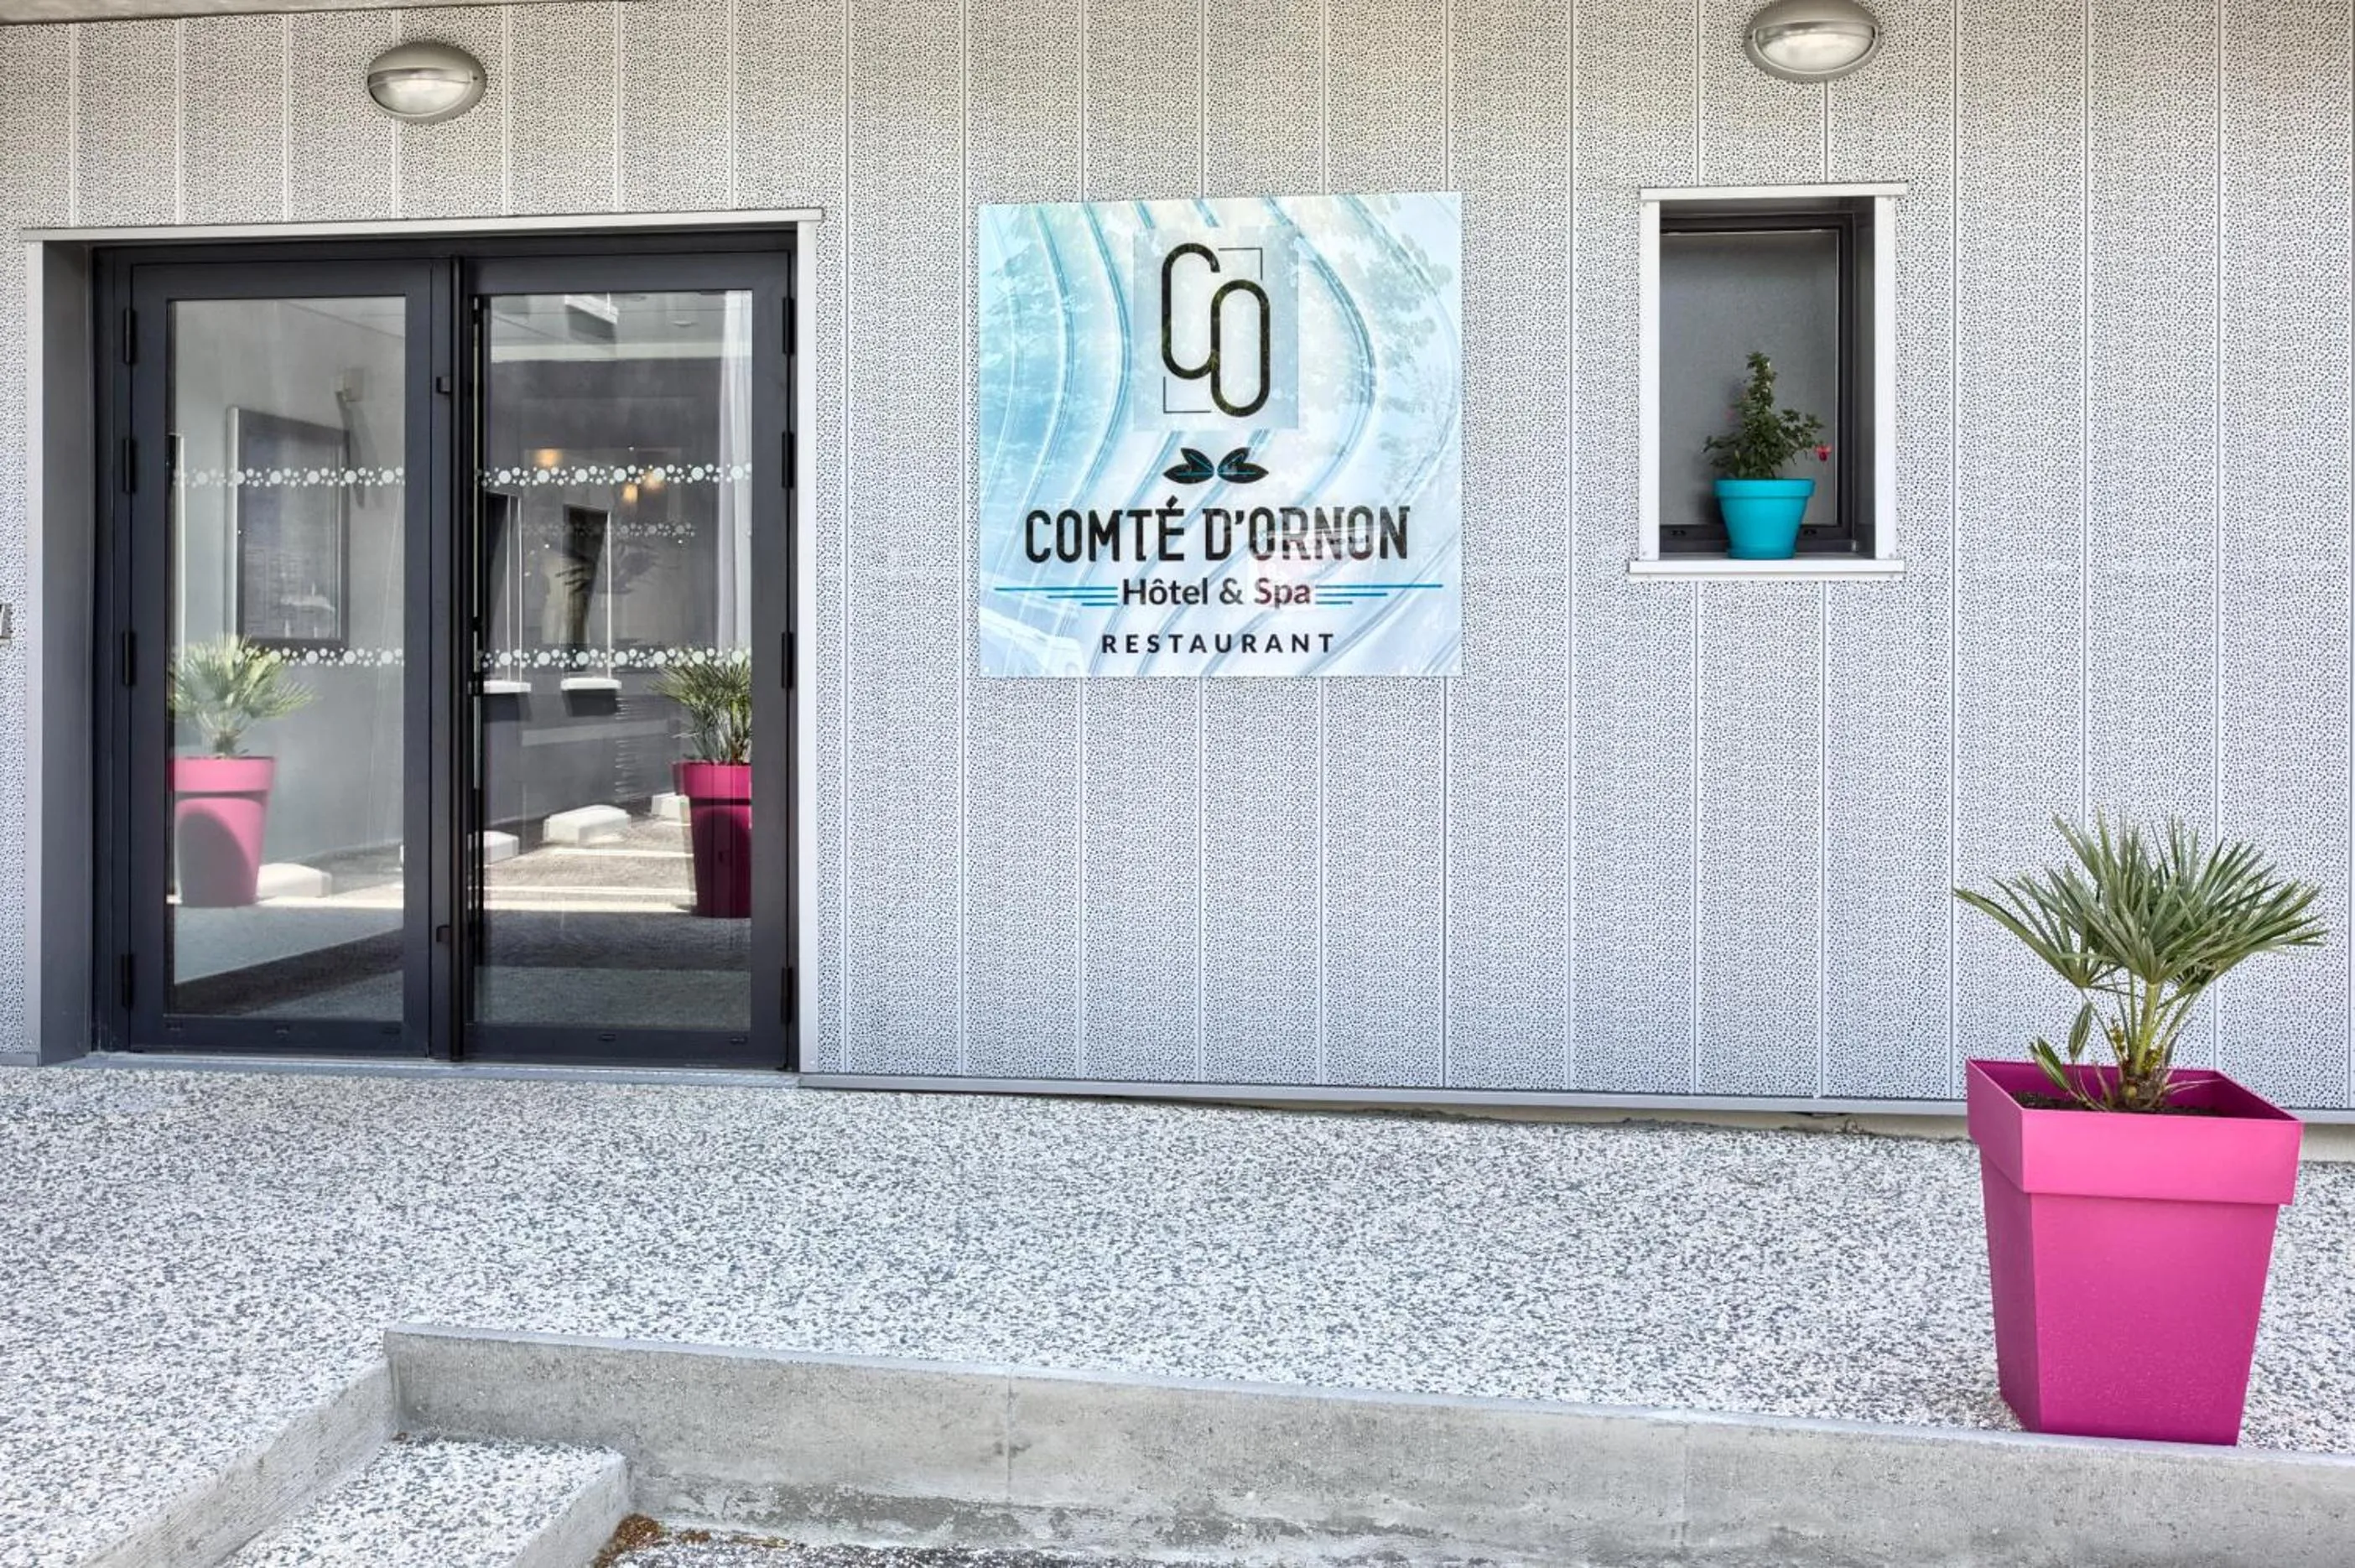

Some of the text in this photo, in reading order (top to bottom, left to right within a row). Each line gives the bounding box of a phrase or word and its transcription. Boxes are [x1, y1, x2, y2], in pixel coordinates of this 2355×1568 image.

[1025, 496, 1411, 563] COMTÉ D'ORNON
[1123, 578, 1311, 609] Hôtel & Spa
[1102, 633, 1333, 654] RESTAURANT
